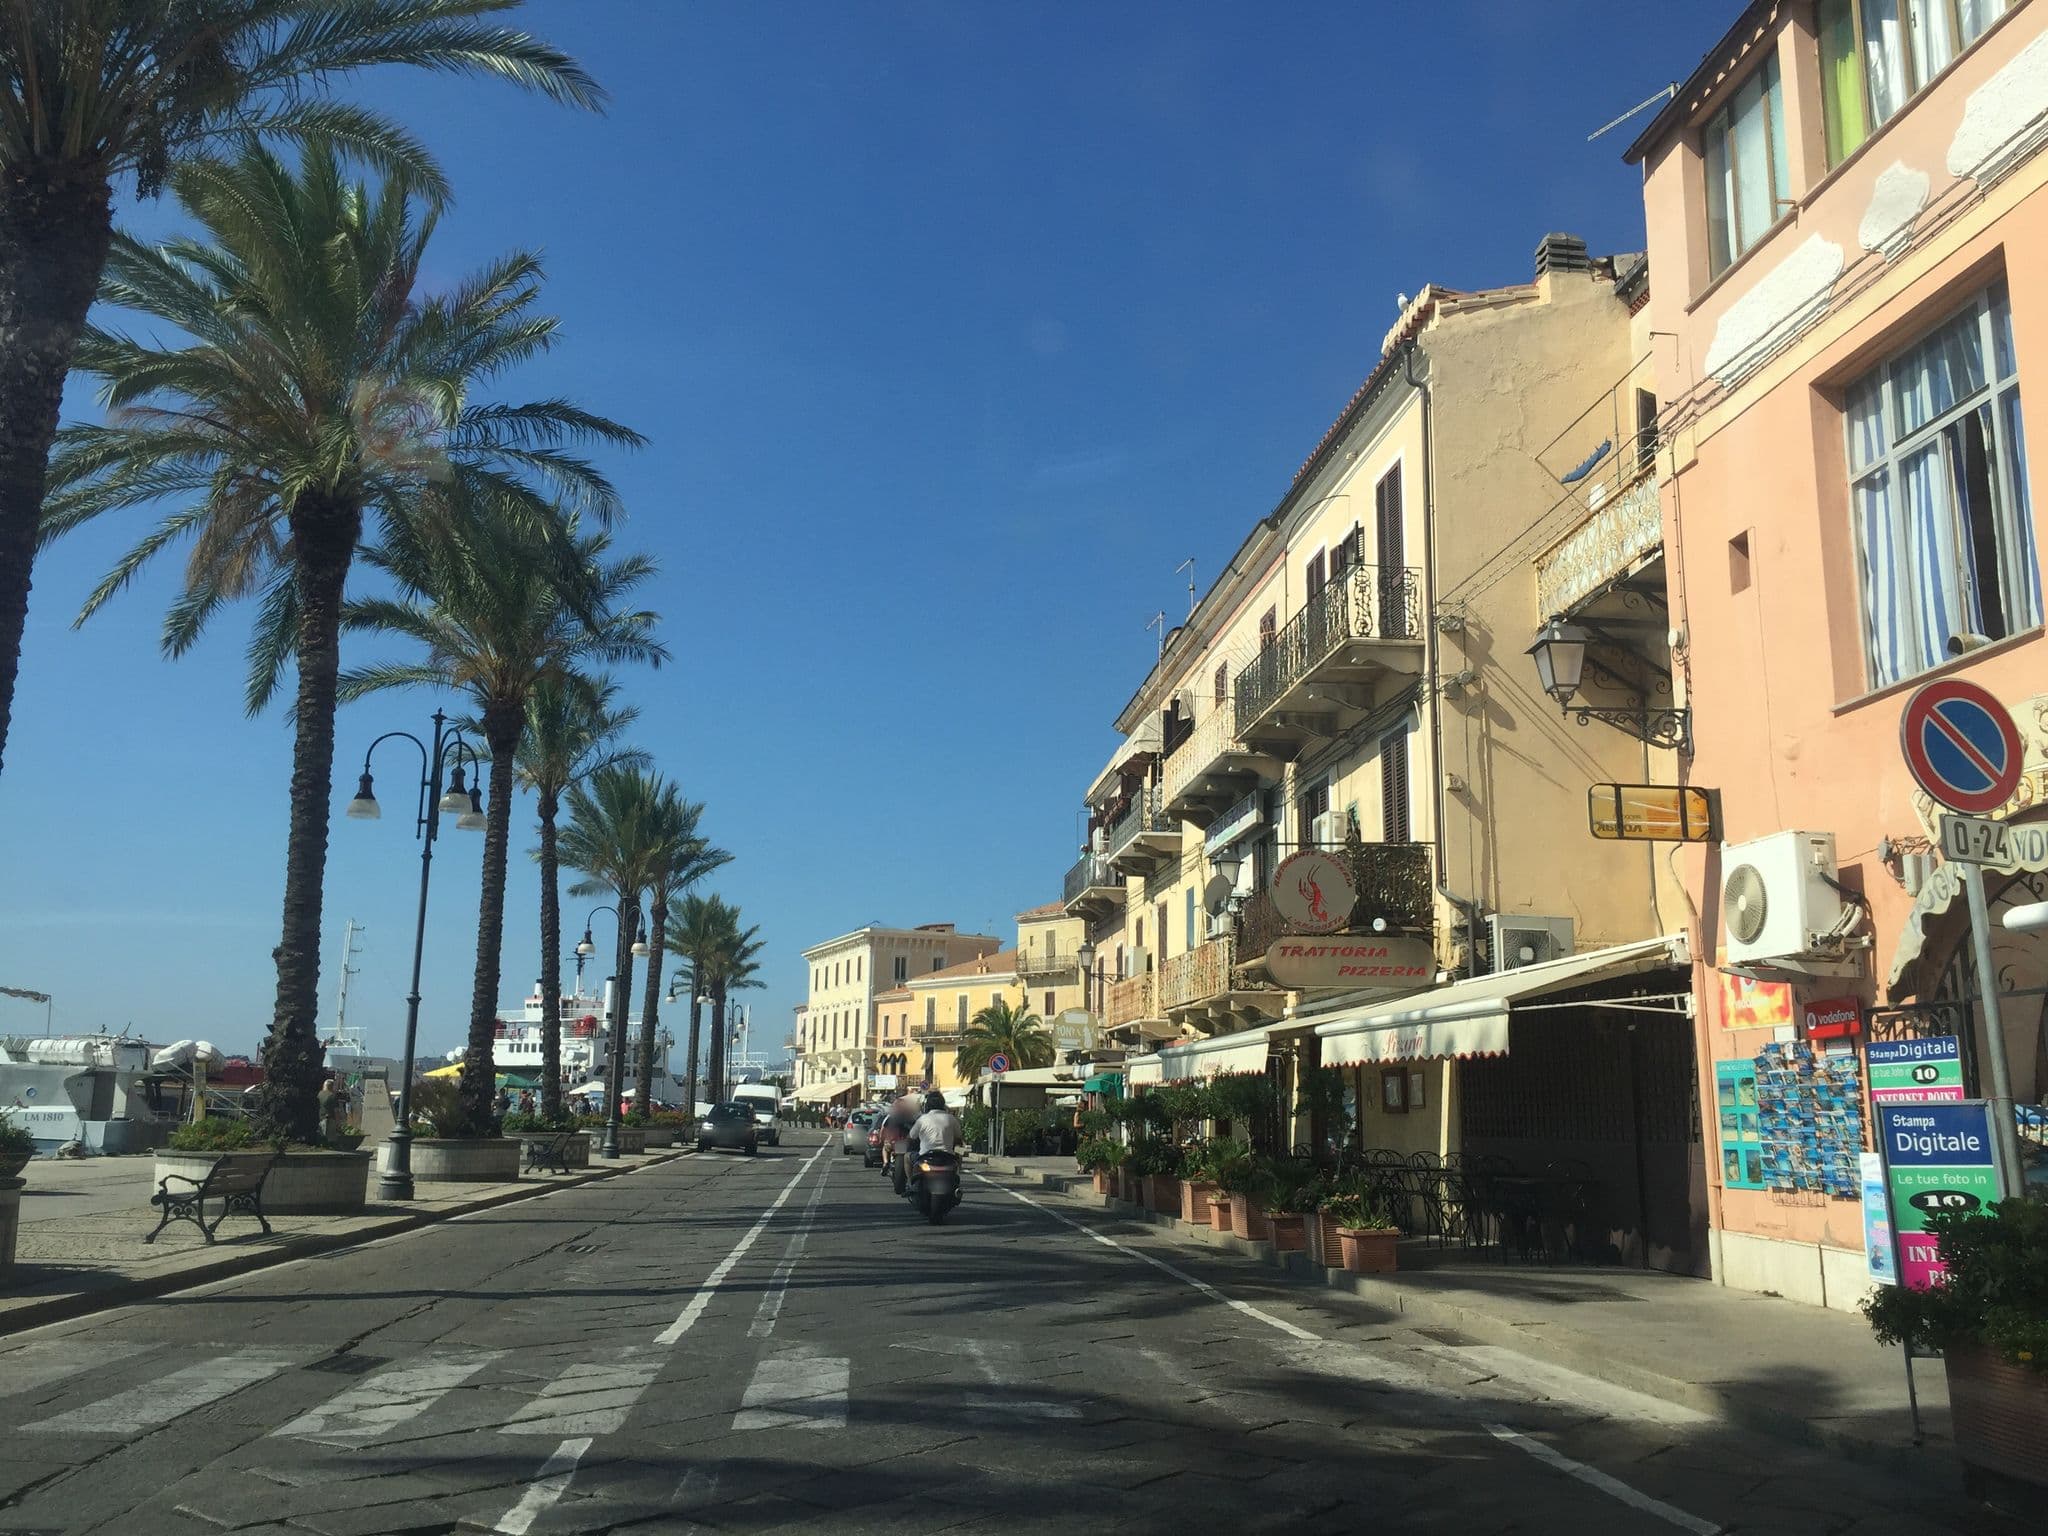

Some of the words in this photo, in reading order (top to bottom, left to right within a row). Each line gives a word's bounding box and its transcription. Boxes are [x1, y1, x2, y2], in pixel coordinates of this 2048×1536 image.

[1953, 821, 2008, 860] 0-24
[1280, 946, 1389, 958] TRATTORIA
[1338, 966, 1426, 977] PIZZERIA
[1817, 1009, 1856, 1025] vodafone
[1869, 1050, 1899, 1060] Stampa
[1898, 1040, 1956, 1059] Digitale
[1915, 1068, 1936, 1081] 10
[24, 1113, 39, 1122] LM
[42, 1112, 65, 1121] 1810
[1892, 1114, 1936, 1131] Stampa
[1896, 1132, 1981, 1156] Digitale
[1897, 1174, 1913, 1185] Le
[1917, 1174, 1939, 1185] tue
[1943, 1173, 1970, 1185] foto
[1975, 1174, 1987, 1185] in
[1923, 1194, 1967, 1207] 10
